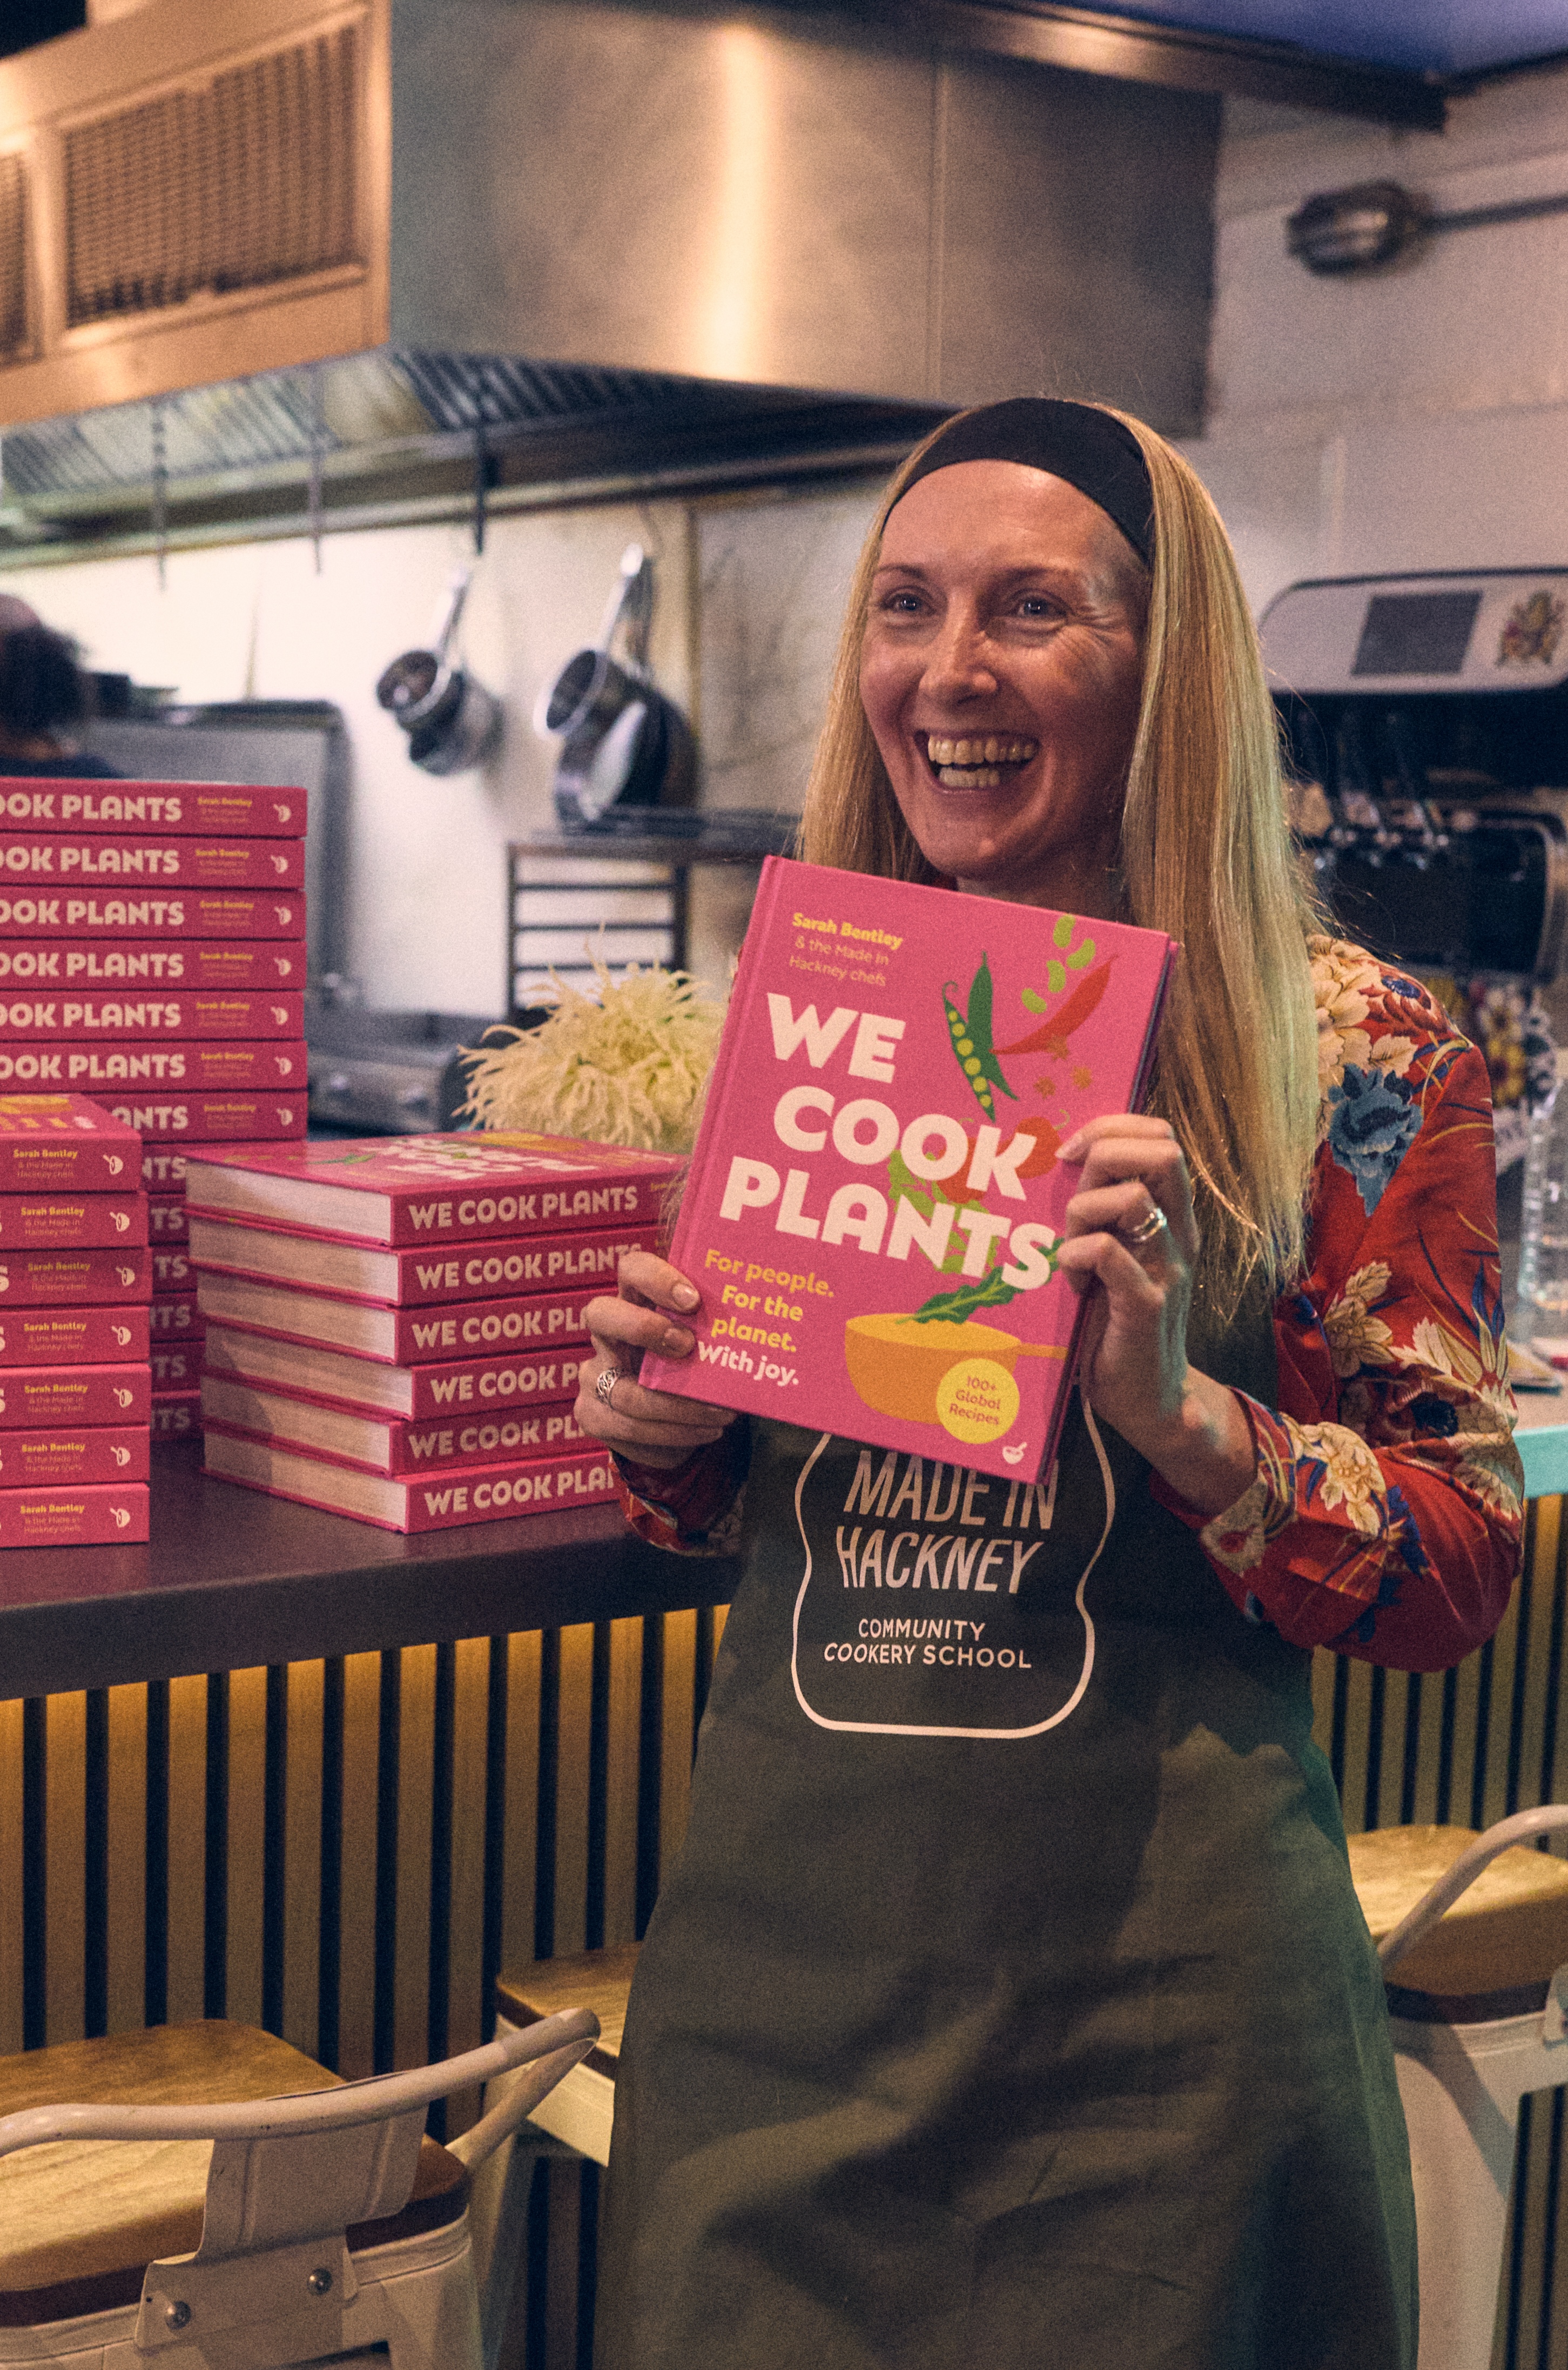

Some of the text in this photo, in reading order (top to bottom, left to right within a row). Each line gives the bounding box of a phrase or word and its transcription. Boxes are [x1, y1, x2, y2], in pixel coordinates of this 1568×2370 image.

[0, 793, 54, 818] OK
[62, 795, 182, 822] PLANTS
[0, 847, 53, 871] OK
[60, 847, 180, 874] PLANTS
[66, 900, 185, 926] PLANTS
[792, 912, 904, 951] Sarah Bentley
[795, 935, 805, 949] &
[809, 938, 832, 955] the
[835, 944, 873, 963] Made
[66, 952, 184, 977] PLANTS
[789, 955, 886, 986] Hackney chefs
[63, 1003, 181, 1028] PLANTS
[767, 992, 906, 1084] WE
[69, 1053, 186, 1078] PLANTS
[14, 1149, 78, 1159] Sarah Bentley
[773, 1085, 1037, 1201] COOK
[21, 1207, 84, 1217] Sarah Bentley
[409, 1186, 638, 1230] WE COOK PLANTS
[719, 1156, 1056, 1290] PLANTS
[28, 1262, 91, 1271] Sarah Bentley
[416, 1261, 460, 1290] WE
[465, 1253, 542, 1285] COOK
[705, 1248, 834, 1298] For people.
[722, 1284, 803, 1322] For the
[24, 1322, 86, 1331] Sarah Bentley
[412, 1320, 456, 1348] WE
[462, 1311, 542, 1343] COOK
[711, 1316, 796, 1353] planet.
[698, 1341, 799, 1387] With joy.
[24, 1384, 88, 1393] Sarah Bentley
[430, 1375, 474, 1403] WE
[479, 1364, 556, 1397] COOK
[949, 1402, 999, 1426] Recipes
[955, 1389, 1001, 1411] Global
[22, 1443, 85, 1452] Sarah Bentley
[408, 1430, 454, 1459] WE
[460, 1420, 541, 1452] COOK
[425, 1487, 468, 1516] WE
[473, 1474, 552, 1509] COOK
[843, 1450, 1059, 1529] MADE IN
[21, 1504, 84, 1514] Sarah Bentley
[836, 1526, 1044, 1594] HACKNEY
[858, 1619, 986, 1641] COMMUNITY
[824, 1643, 1031, 1668] COOKERY SCHOOL
